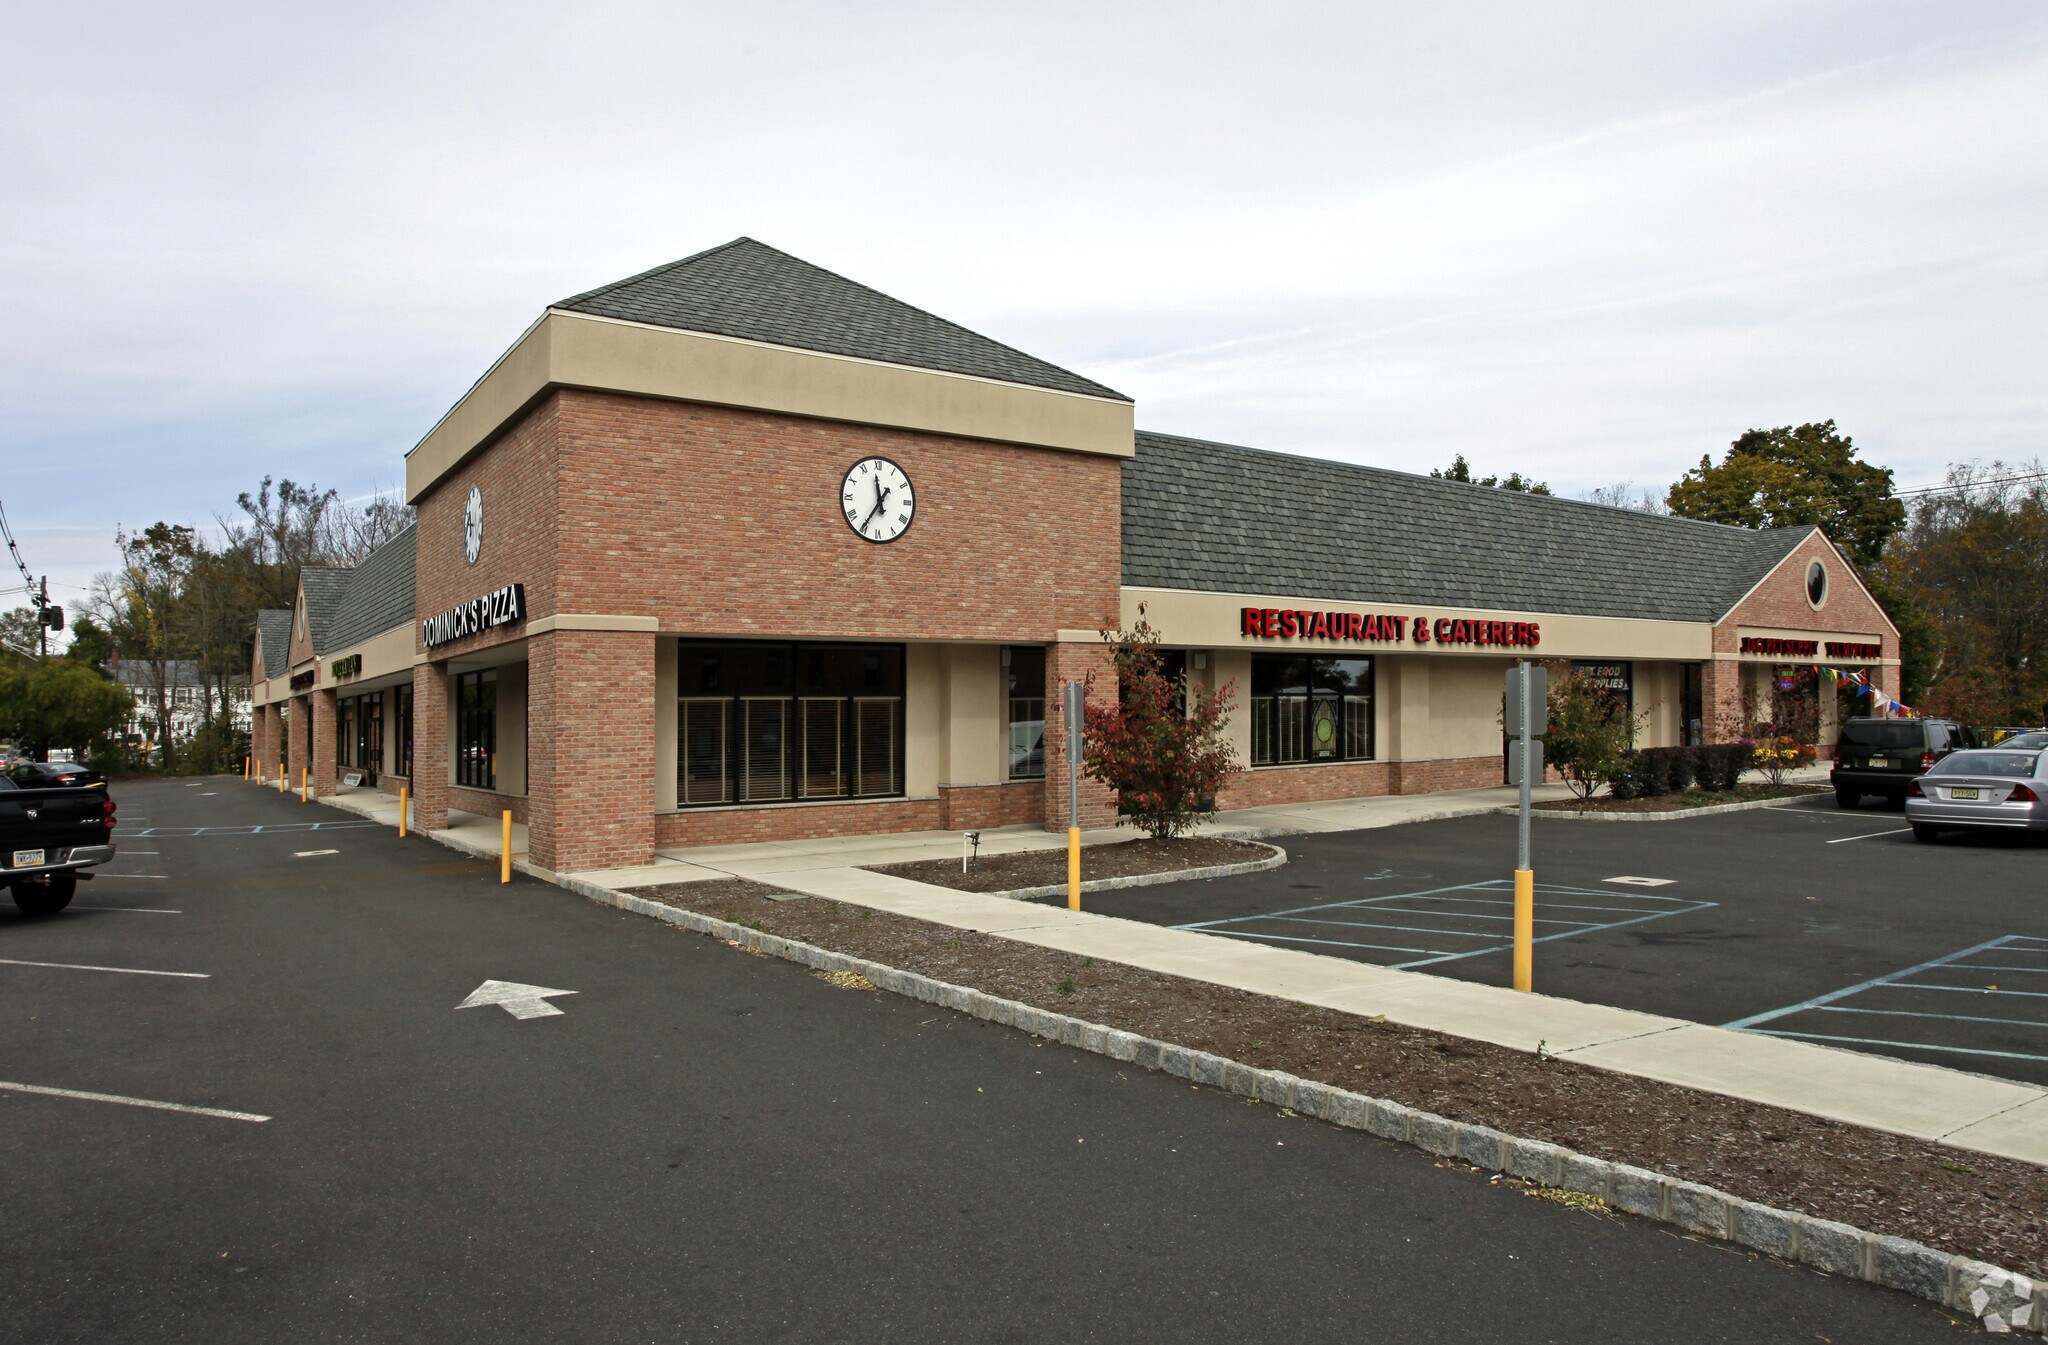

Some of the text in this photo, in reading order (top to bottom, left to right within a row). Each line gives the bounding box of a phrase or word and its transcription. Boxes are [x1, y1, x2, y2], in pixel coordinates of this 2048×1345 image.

[848, 476, 857, 485] X
[422, 583, 519, 648] DOMINICK'S PIZZA
[1241, 607, 1541, 646] RESTAURANT & CATERERS
[1583, 678, 1625, 689] SPPLIES
